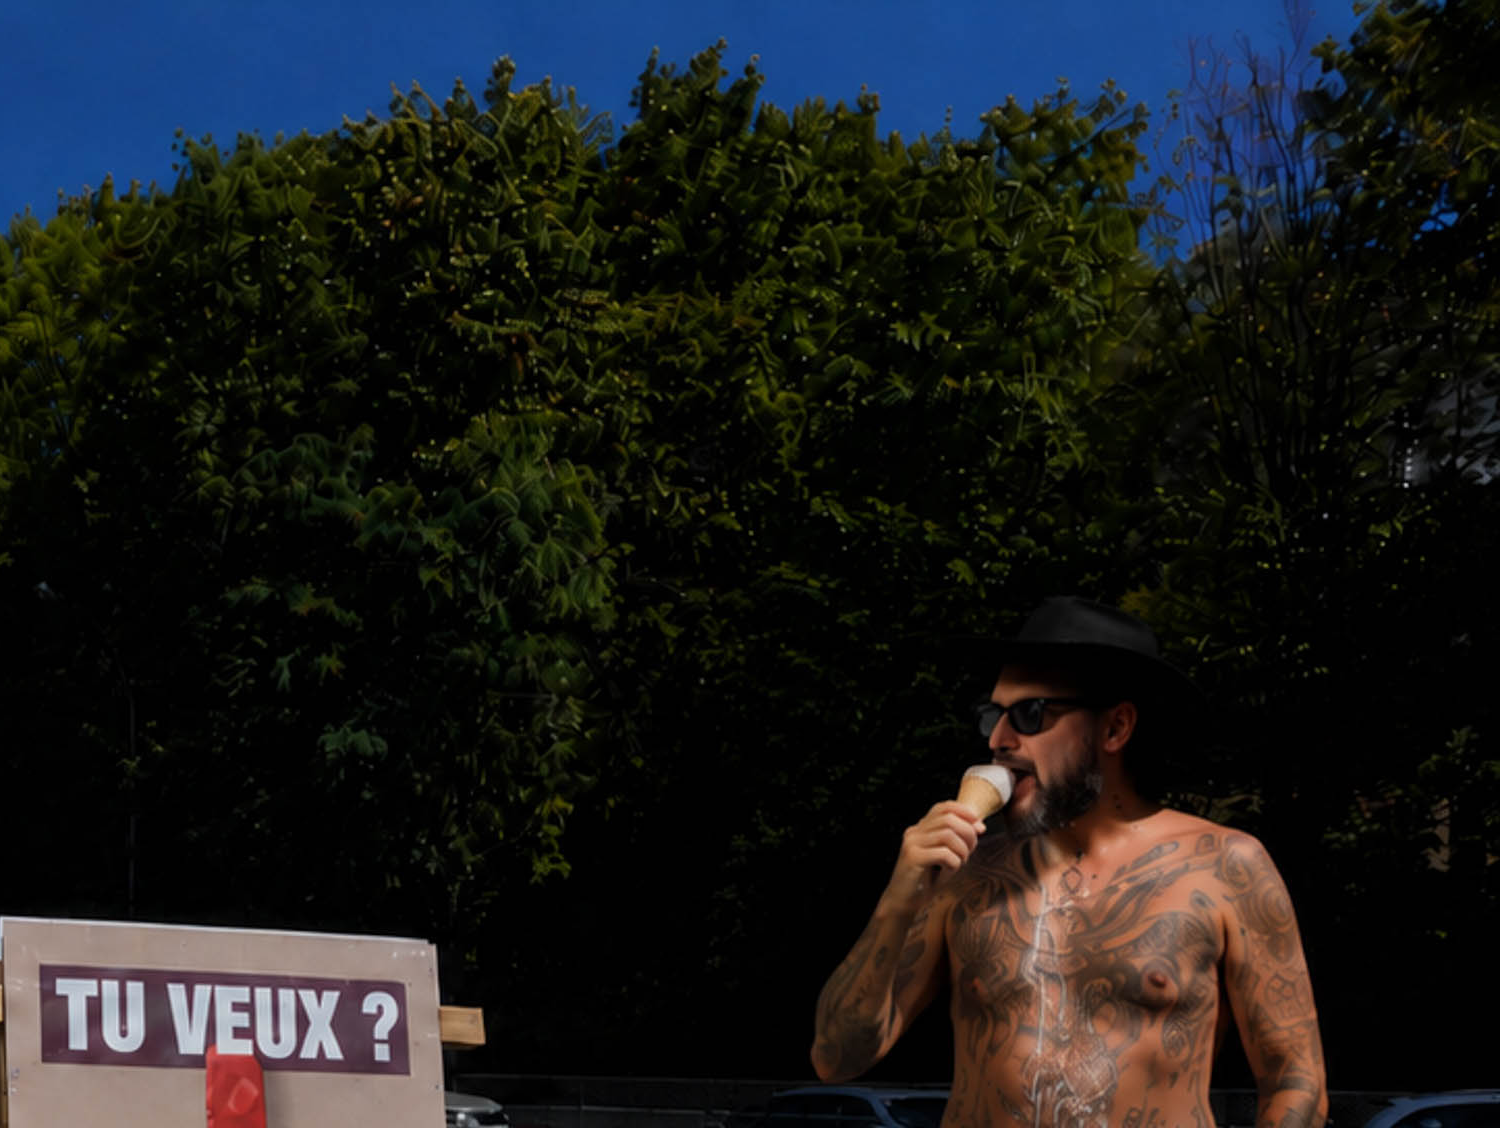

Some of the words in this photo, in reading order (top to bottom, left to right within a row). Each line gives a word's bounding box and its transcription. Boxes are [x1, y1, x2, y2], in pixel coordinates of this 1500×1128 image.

[55, 978, 146, 1053] TU
[166, 982, 344, 1061] VEUX
[361, 992, 400, 1062] ?
